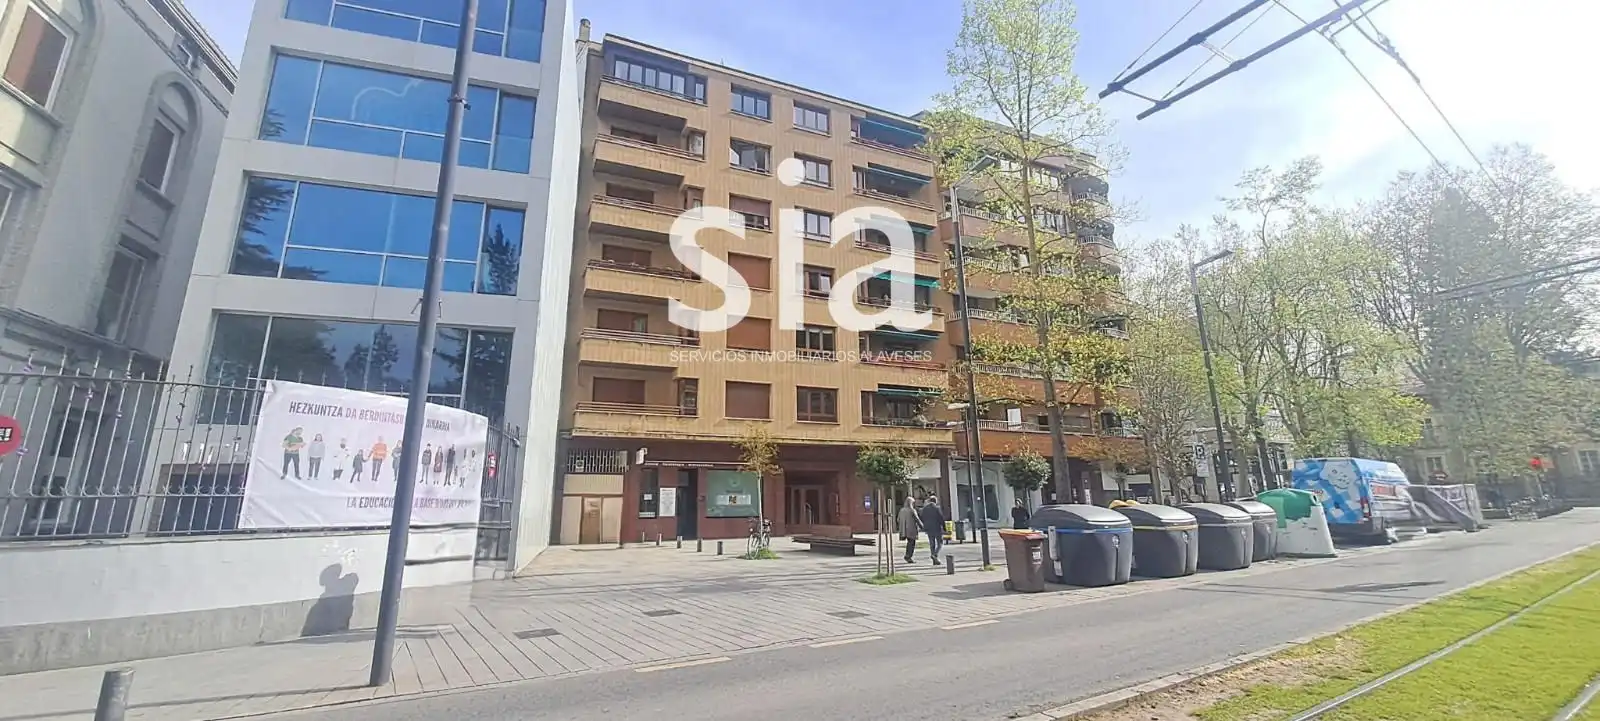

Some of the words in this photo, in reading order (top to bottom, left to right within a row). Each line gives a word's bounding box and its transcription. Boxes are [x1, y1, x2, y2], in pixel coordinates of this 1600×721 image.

[289, 401, 342, 417] HEZKUNTZA
[345, 408, 356, 419] DA
[358, 409, 405, 425] BERDINTASU
